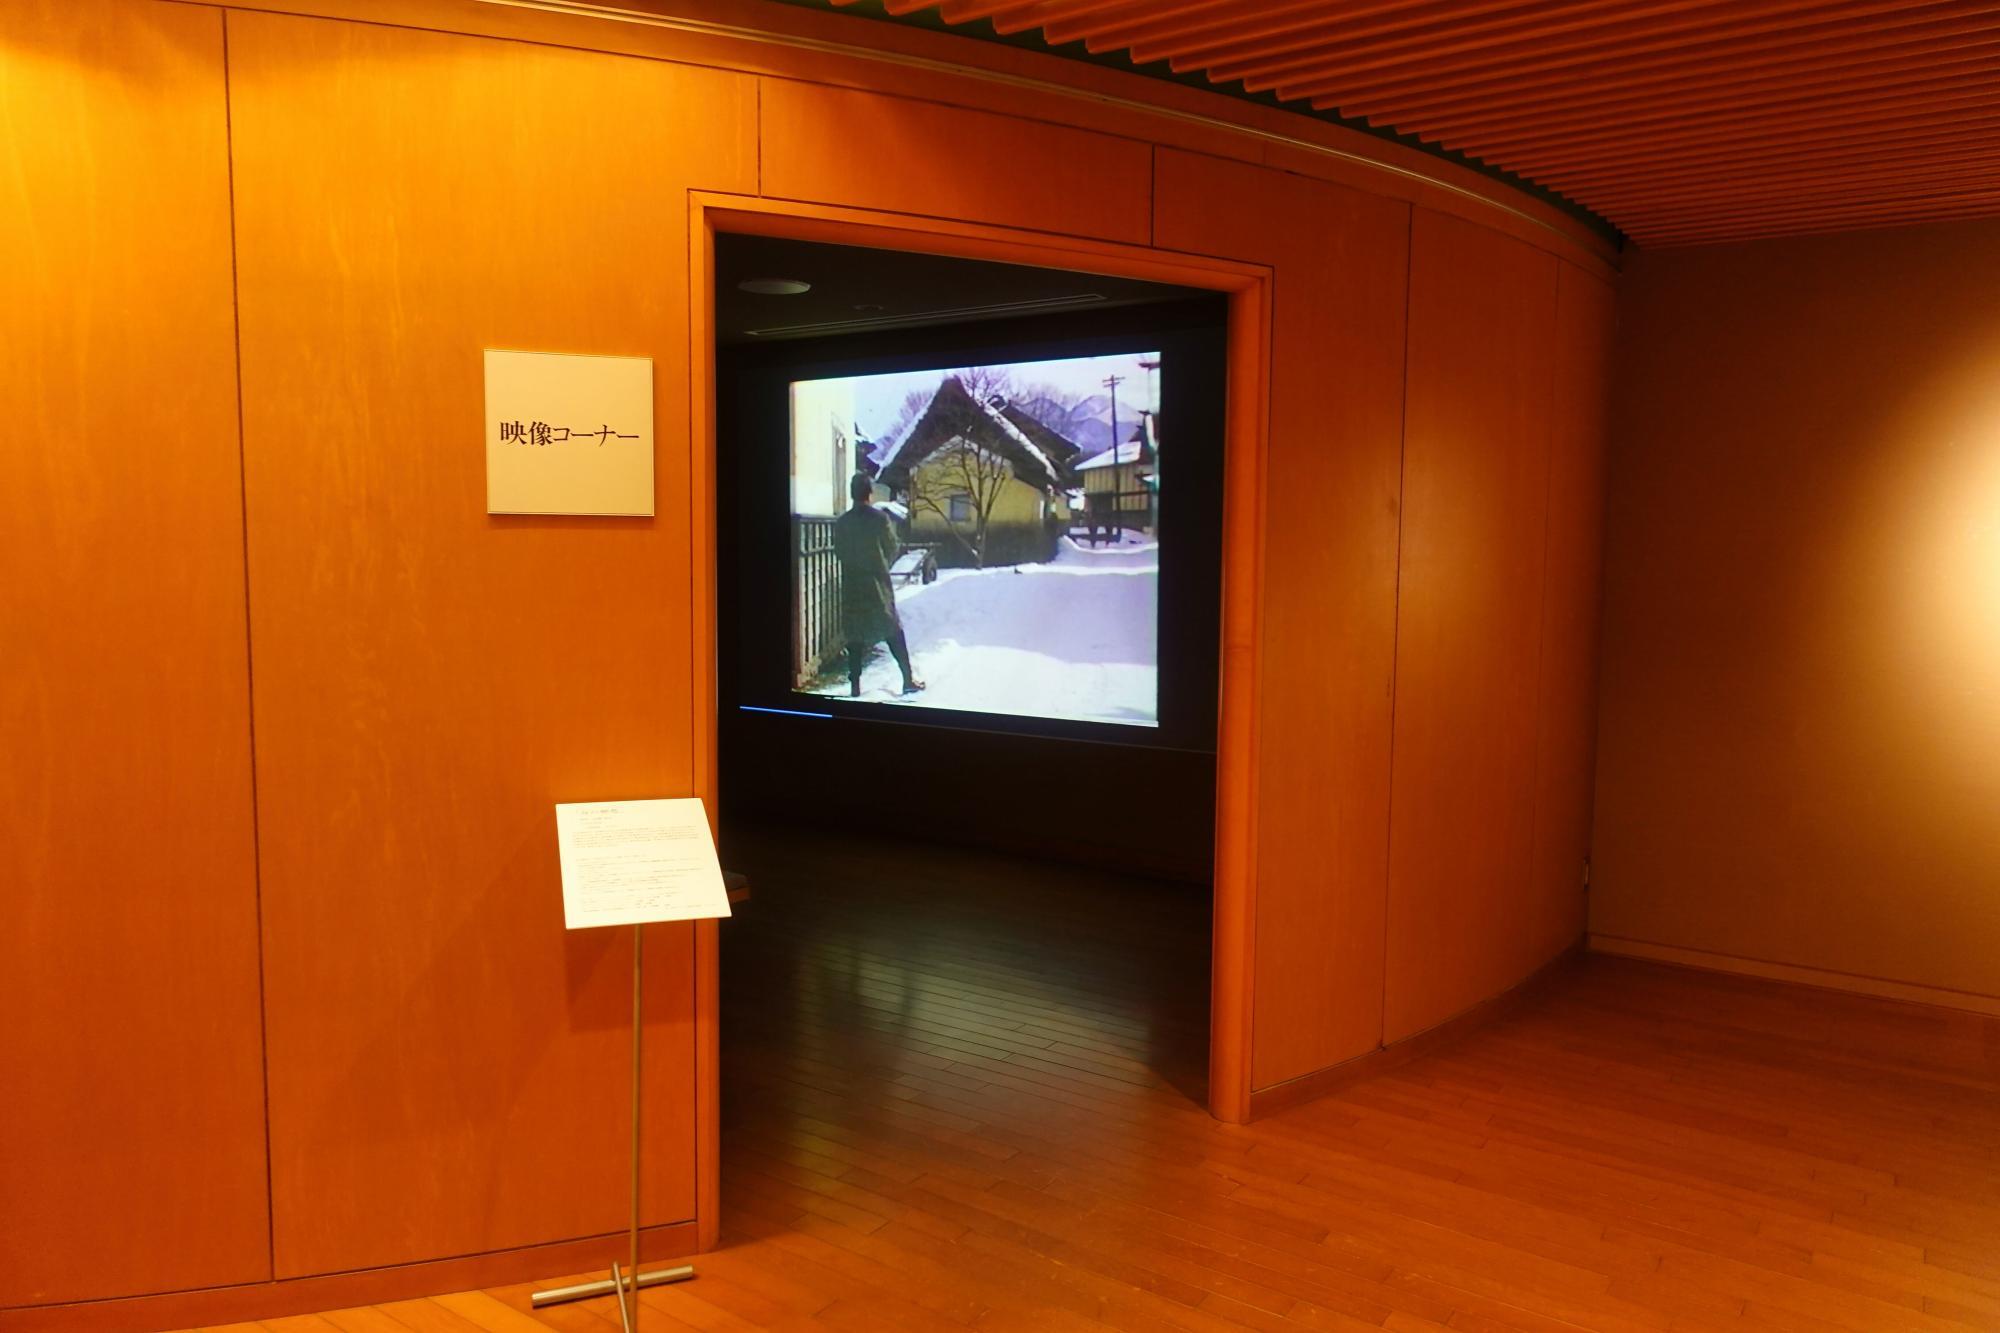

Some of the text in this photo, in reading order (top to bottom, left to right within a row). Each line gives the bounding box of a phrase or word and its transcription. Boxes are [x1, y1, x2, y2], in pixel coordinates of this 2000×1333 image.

[500, 420, 640, 447] 映像コーナー
